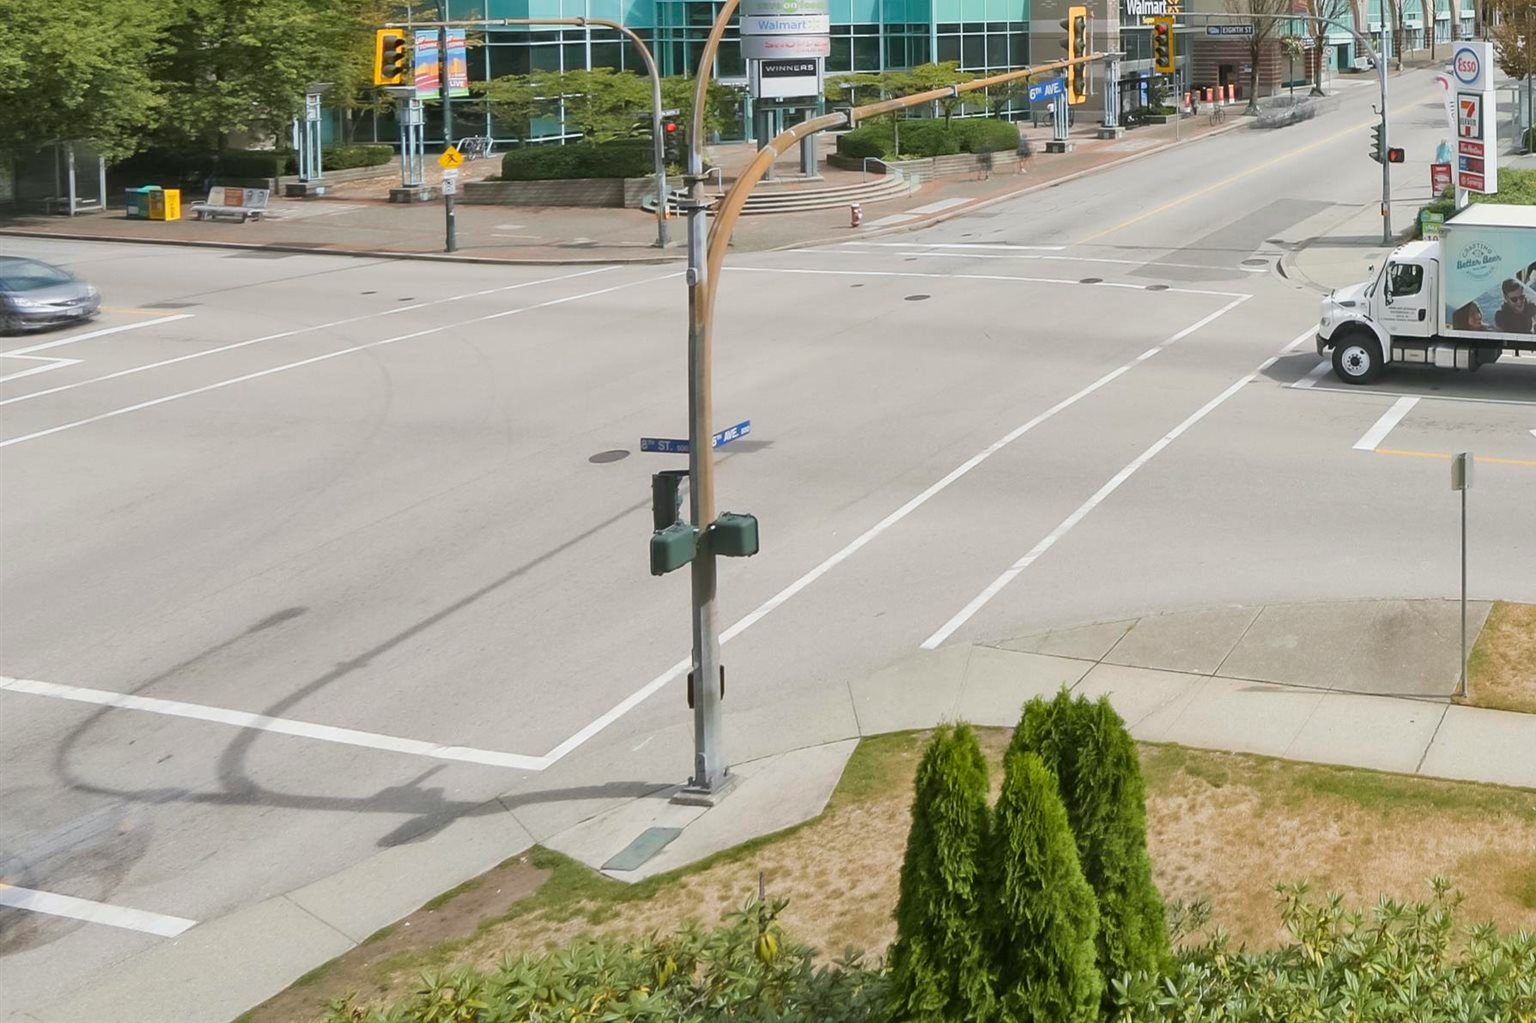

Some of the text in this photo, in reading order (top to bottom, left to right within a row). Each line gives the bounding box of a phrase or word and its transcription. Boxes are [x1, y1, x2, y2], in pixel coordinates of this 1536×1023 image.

[758, 20, 806, 30] Walmart
[765, 64, 814, 73] WINNERS
[1458, 58, 1477, 73] Esso
[1457, 259, 1481, 269] Better
